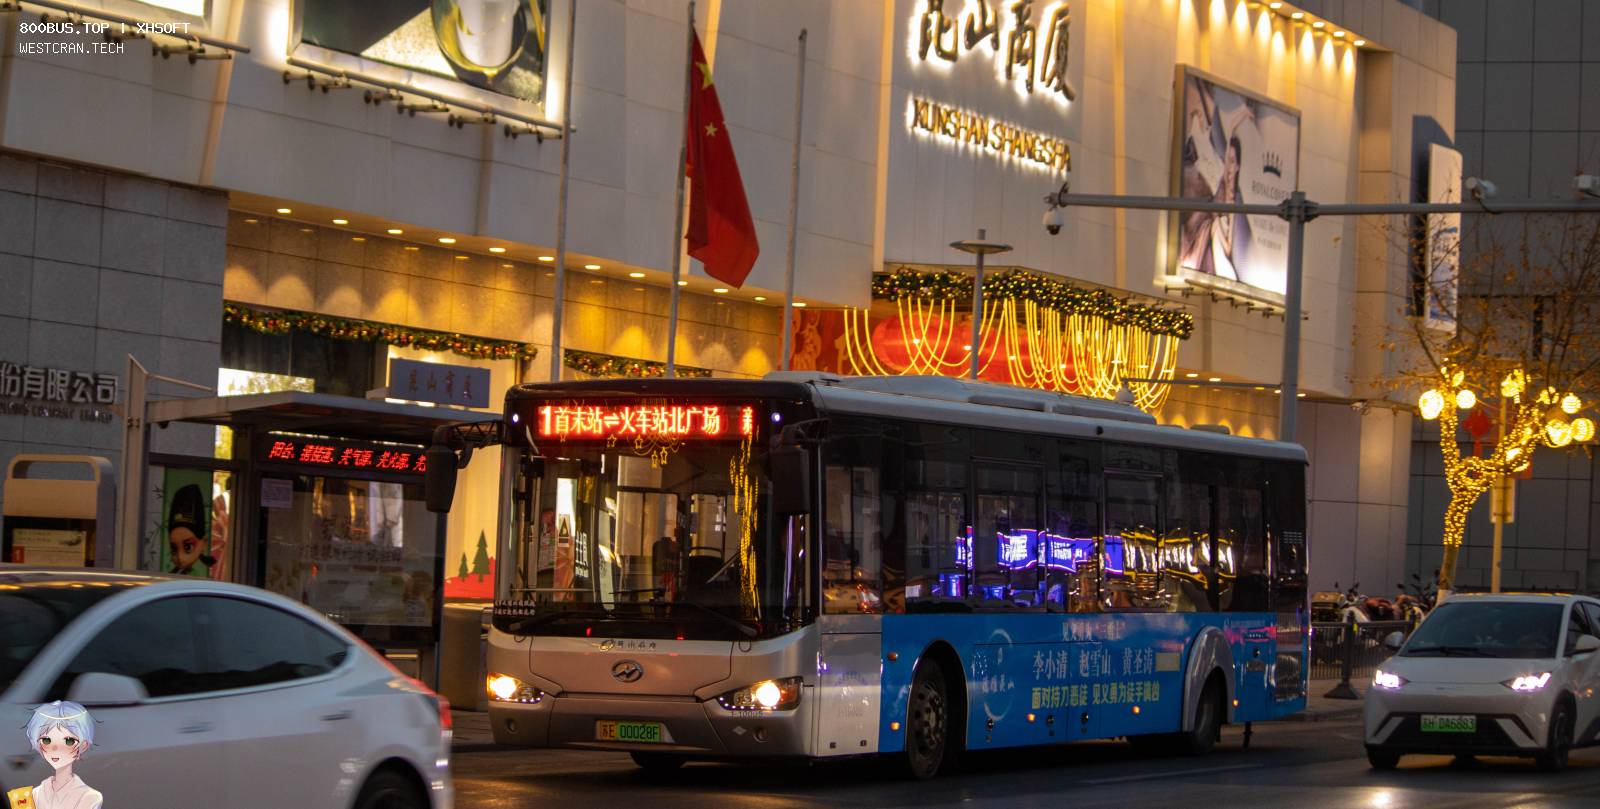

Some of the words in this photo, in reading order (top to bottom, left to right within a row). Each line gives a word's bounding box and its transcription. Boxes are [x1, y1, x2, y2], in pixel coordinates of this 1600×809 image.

[913, 99, 990, 148] KUNSHAN
[990, 122, 1072, 172] SHANGSHA
[0, 363, 118, 404] 份有限公司
